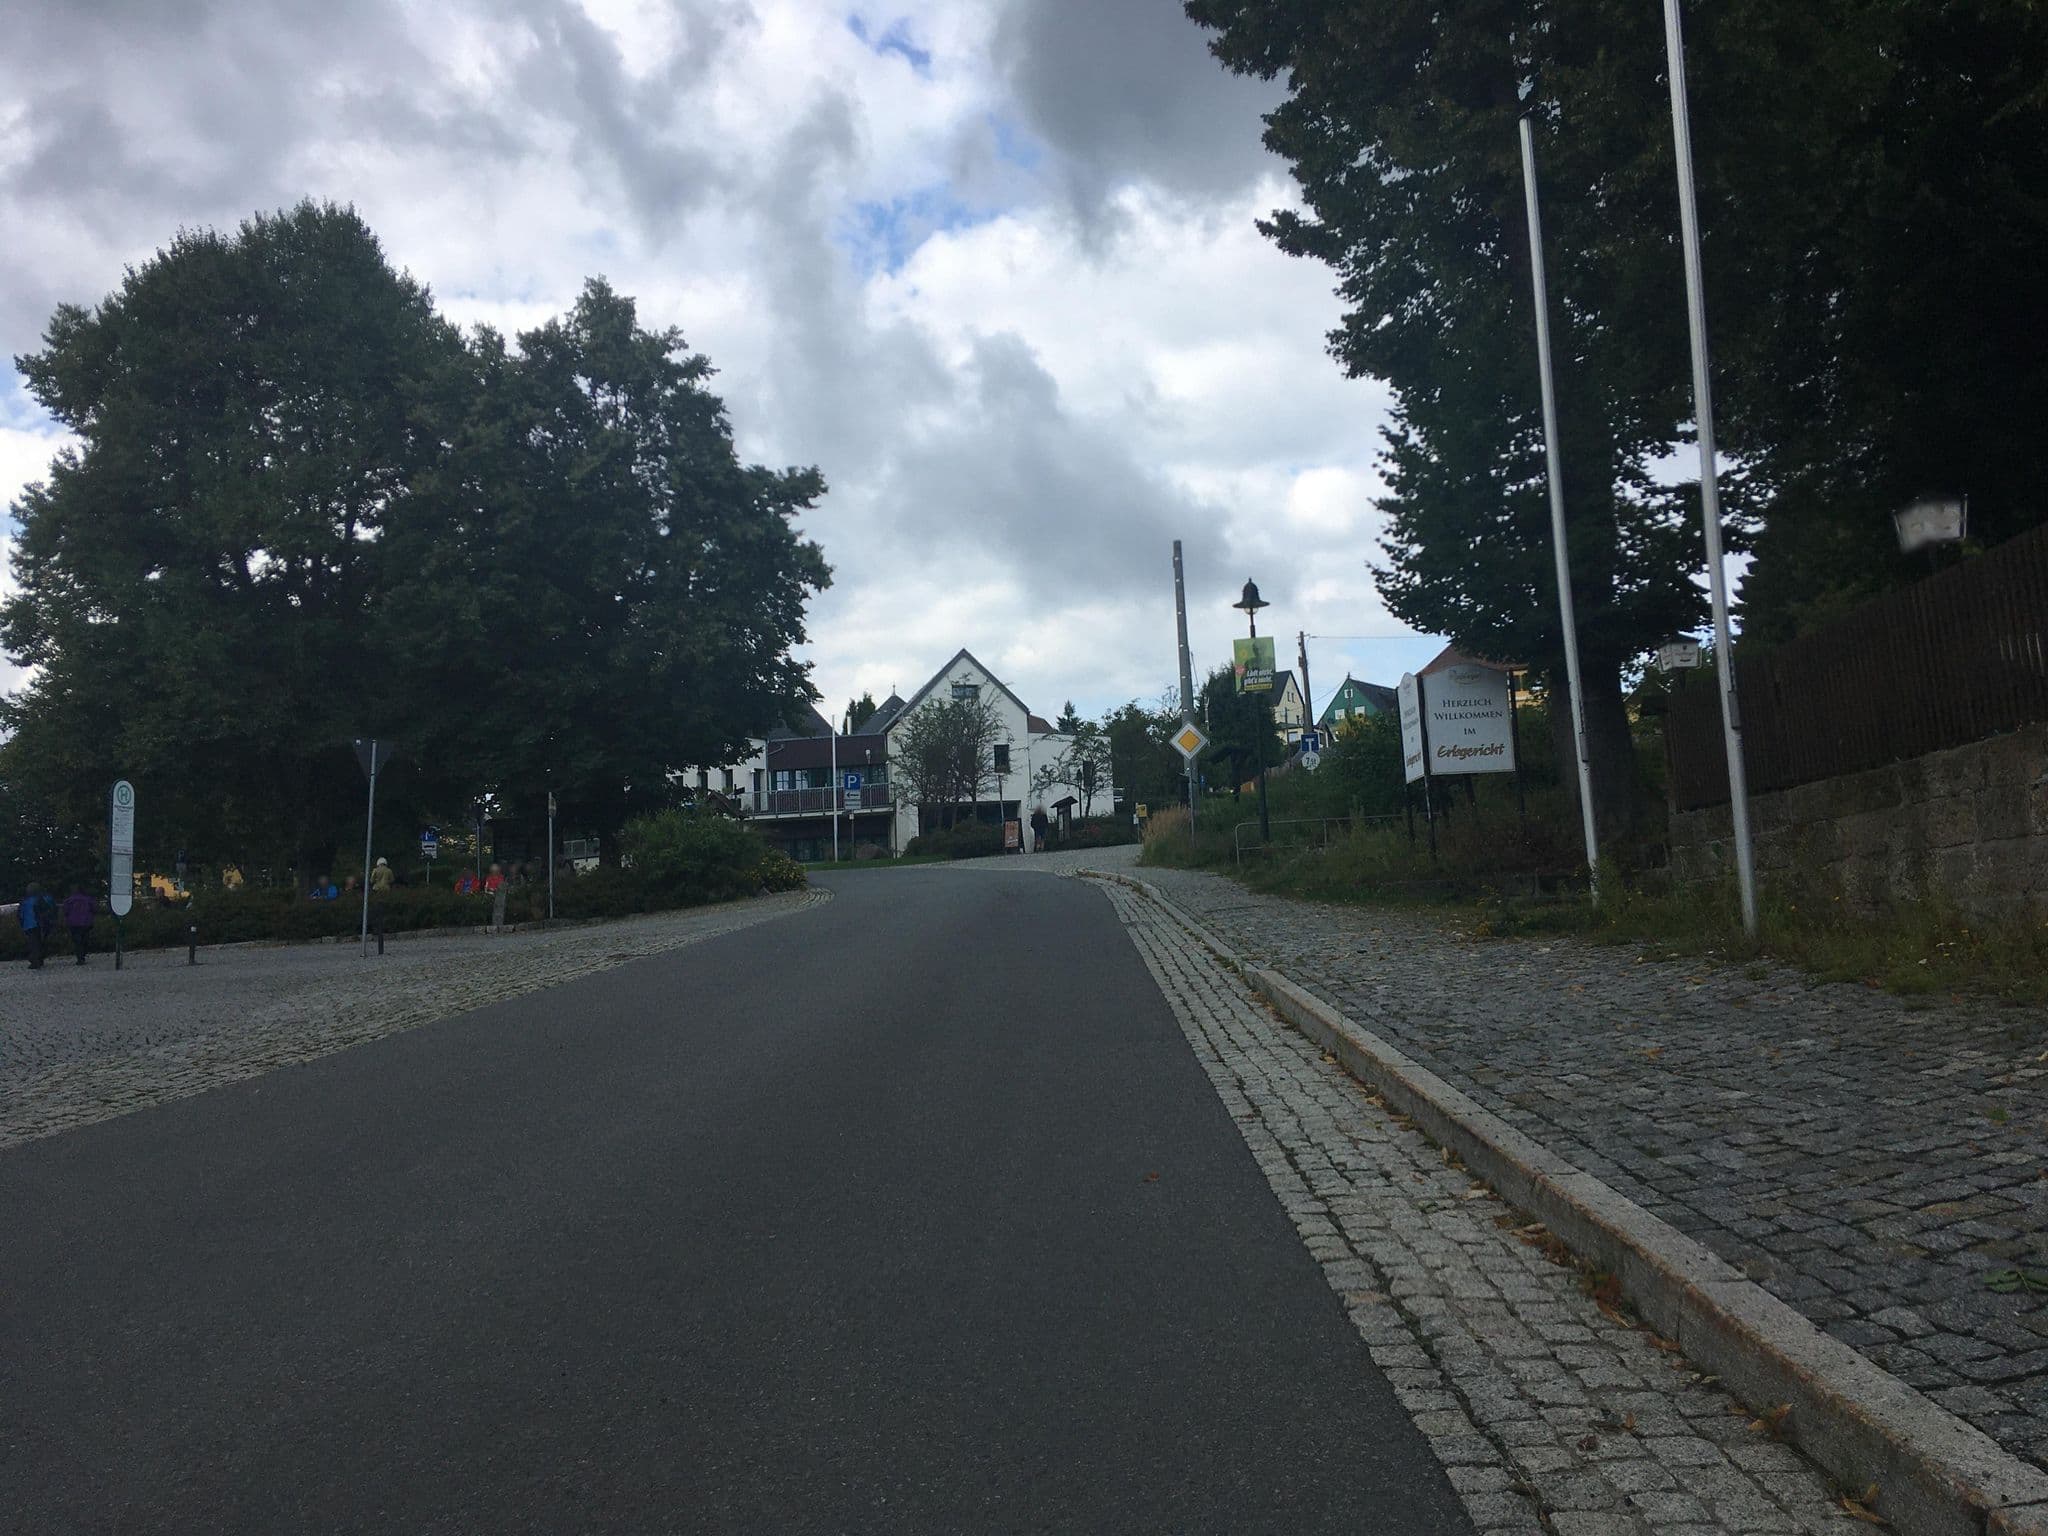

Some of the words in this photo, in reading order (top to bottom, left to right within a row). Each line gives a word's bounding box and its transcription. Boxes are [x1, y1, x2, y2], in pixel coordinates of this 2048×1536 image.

[1442, 698, 1492, 708] HERZLICH
[1434, 711, 1503, 721] WILLKOMMEN
[1464, 727, 1476, 735] IM
[1437, 743, 1505, 760] Erbgericht
[848, 775, 857, 788] P
